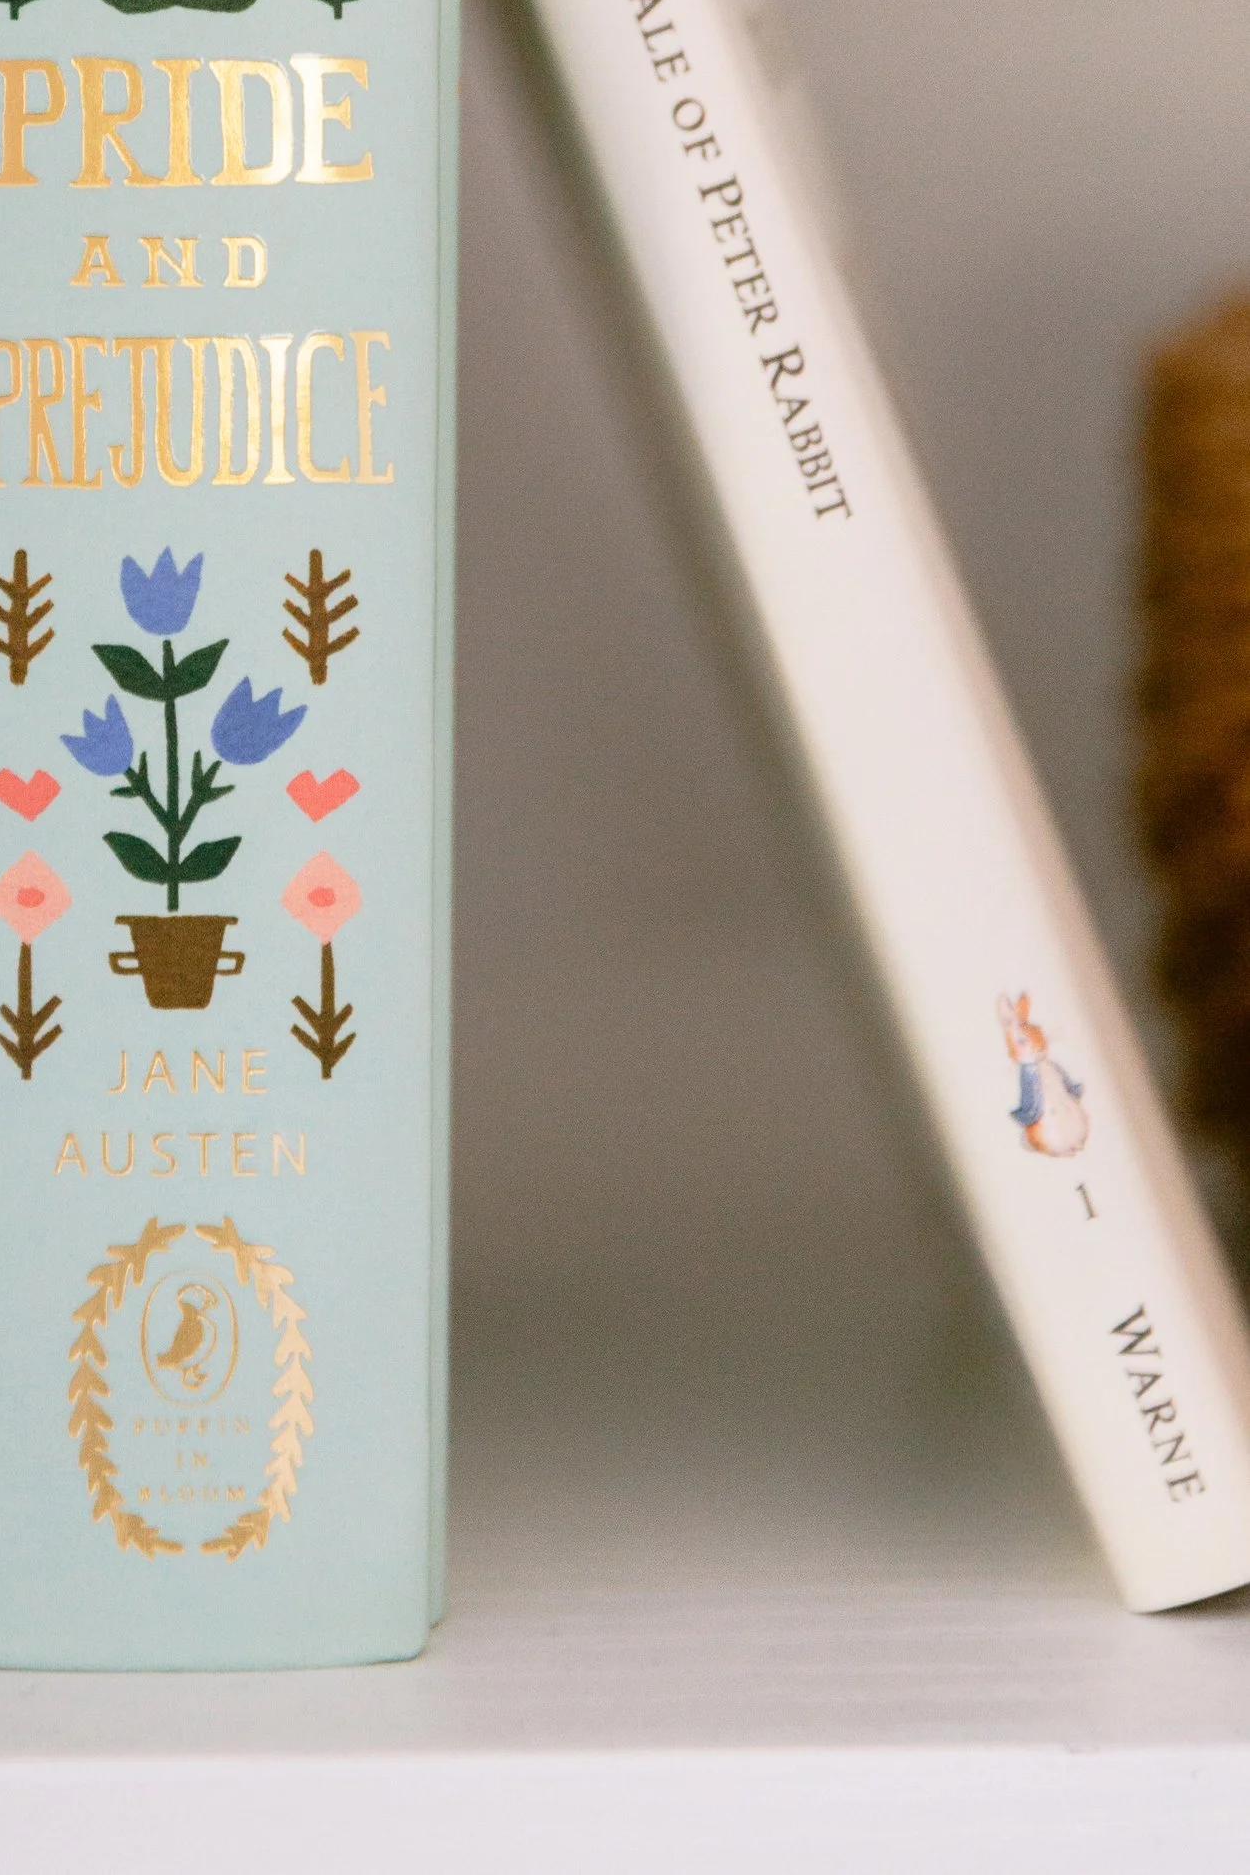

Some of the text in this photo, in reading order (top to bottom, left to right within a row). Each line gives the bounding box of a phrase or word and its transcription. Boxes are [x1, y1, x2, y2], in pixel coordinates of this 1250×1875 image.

[69, 235, 268, 288] AND
[671, 96, 723, 162] OF
[697, 173, 781, 336] PETER
[760, 343, 854, 522] RABBIT
[107, 1049, 269, 1094] JANE
[54, 1132, 309, 1177] AUSTEN
[1108, 1303, 1206, 1503] WARNE
[132, 1416, 252, 1437] PUFFIN
[175, 1450, 210, 1472] IN
